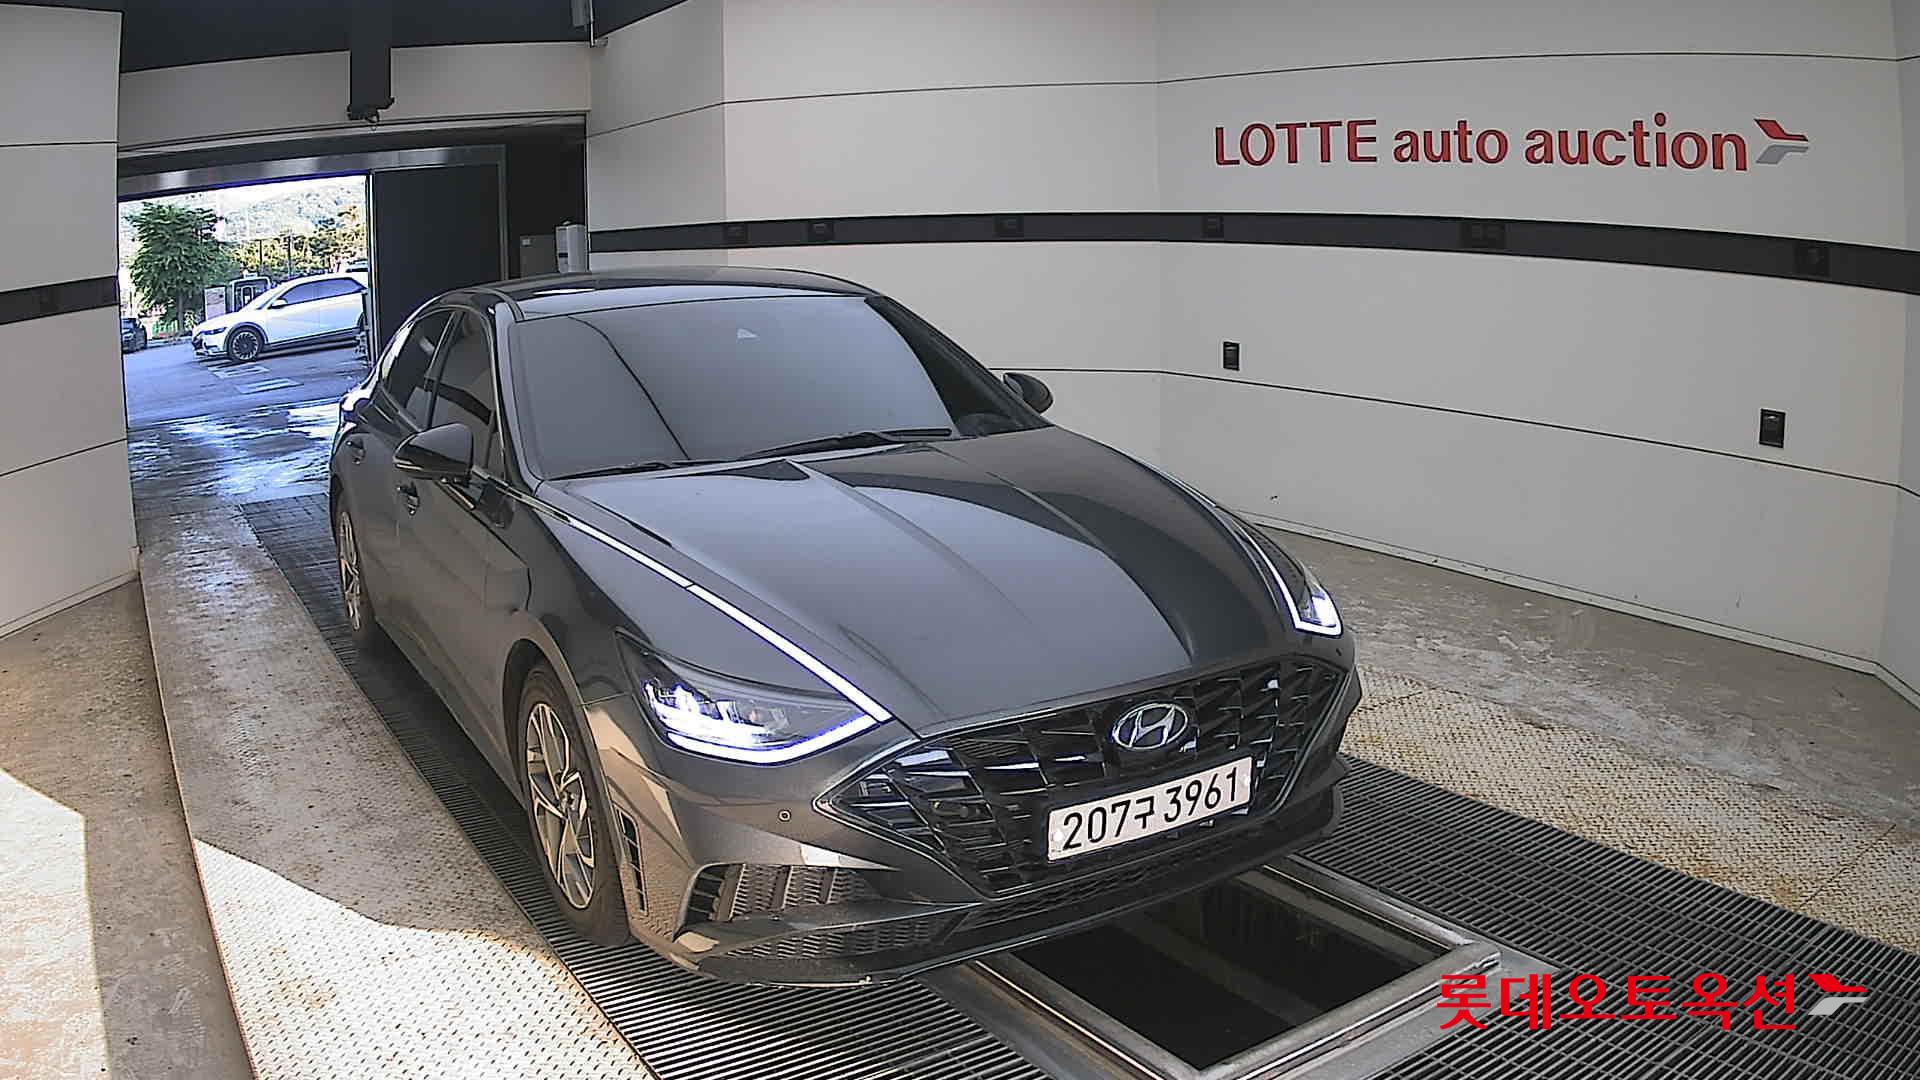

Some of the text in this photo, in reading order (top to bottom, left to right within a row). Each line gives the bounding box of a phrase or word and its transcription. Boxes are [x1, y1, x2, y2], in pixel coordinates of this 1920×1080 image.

[1215, 112, 1748, 172] LOTTE auto auction
